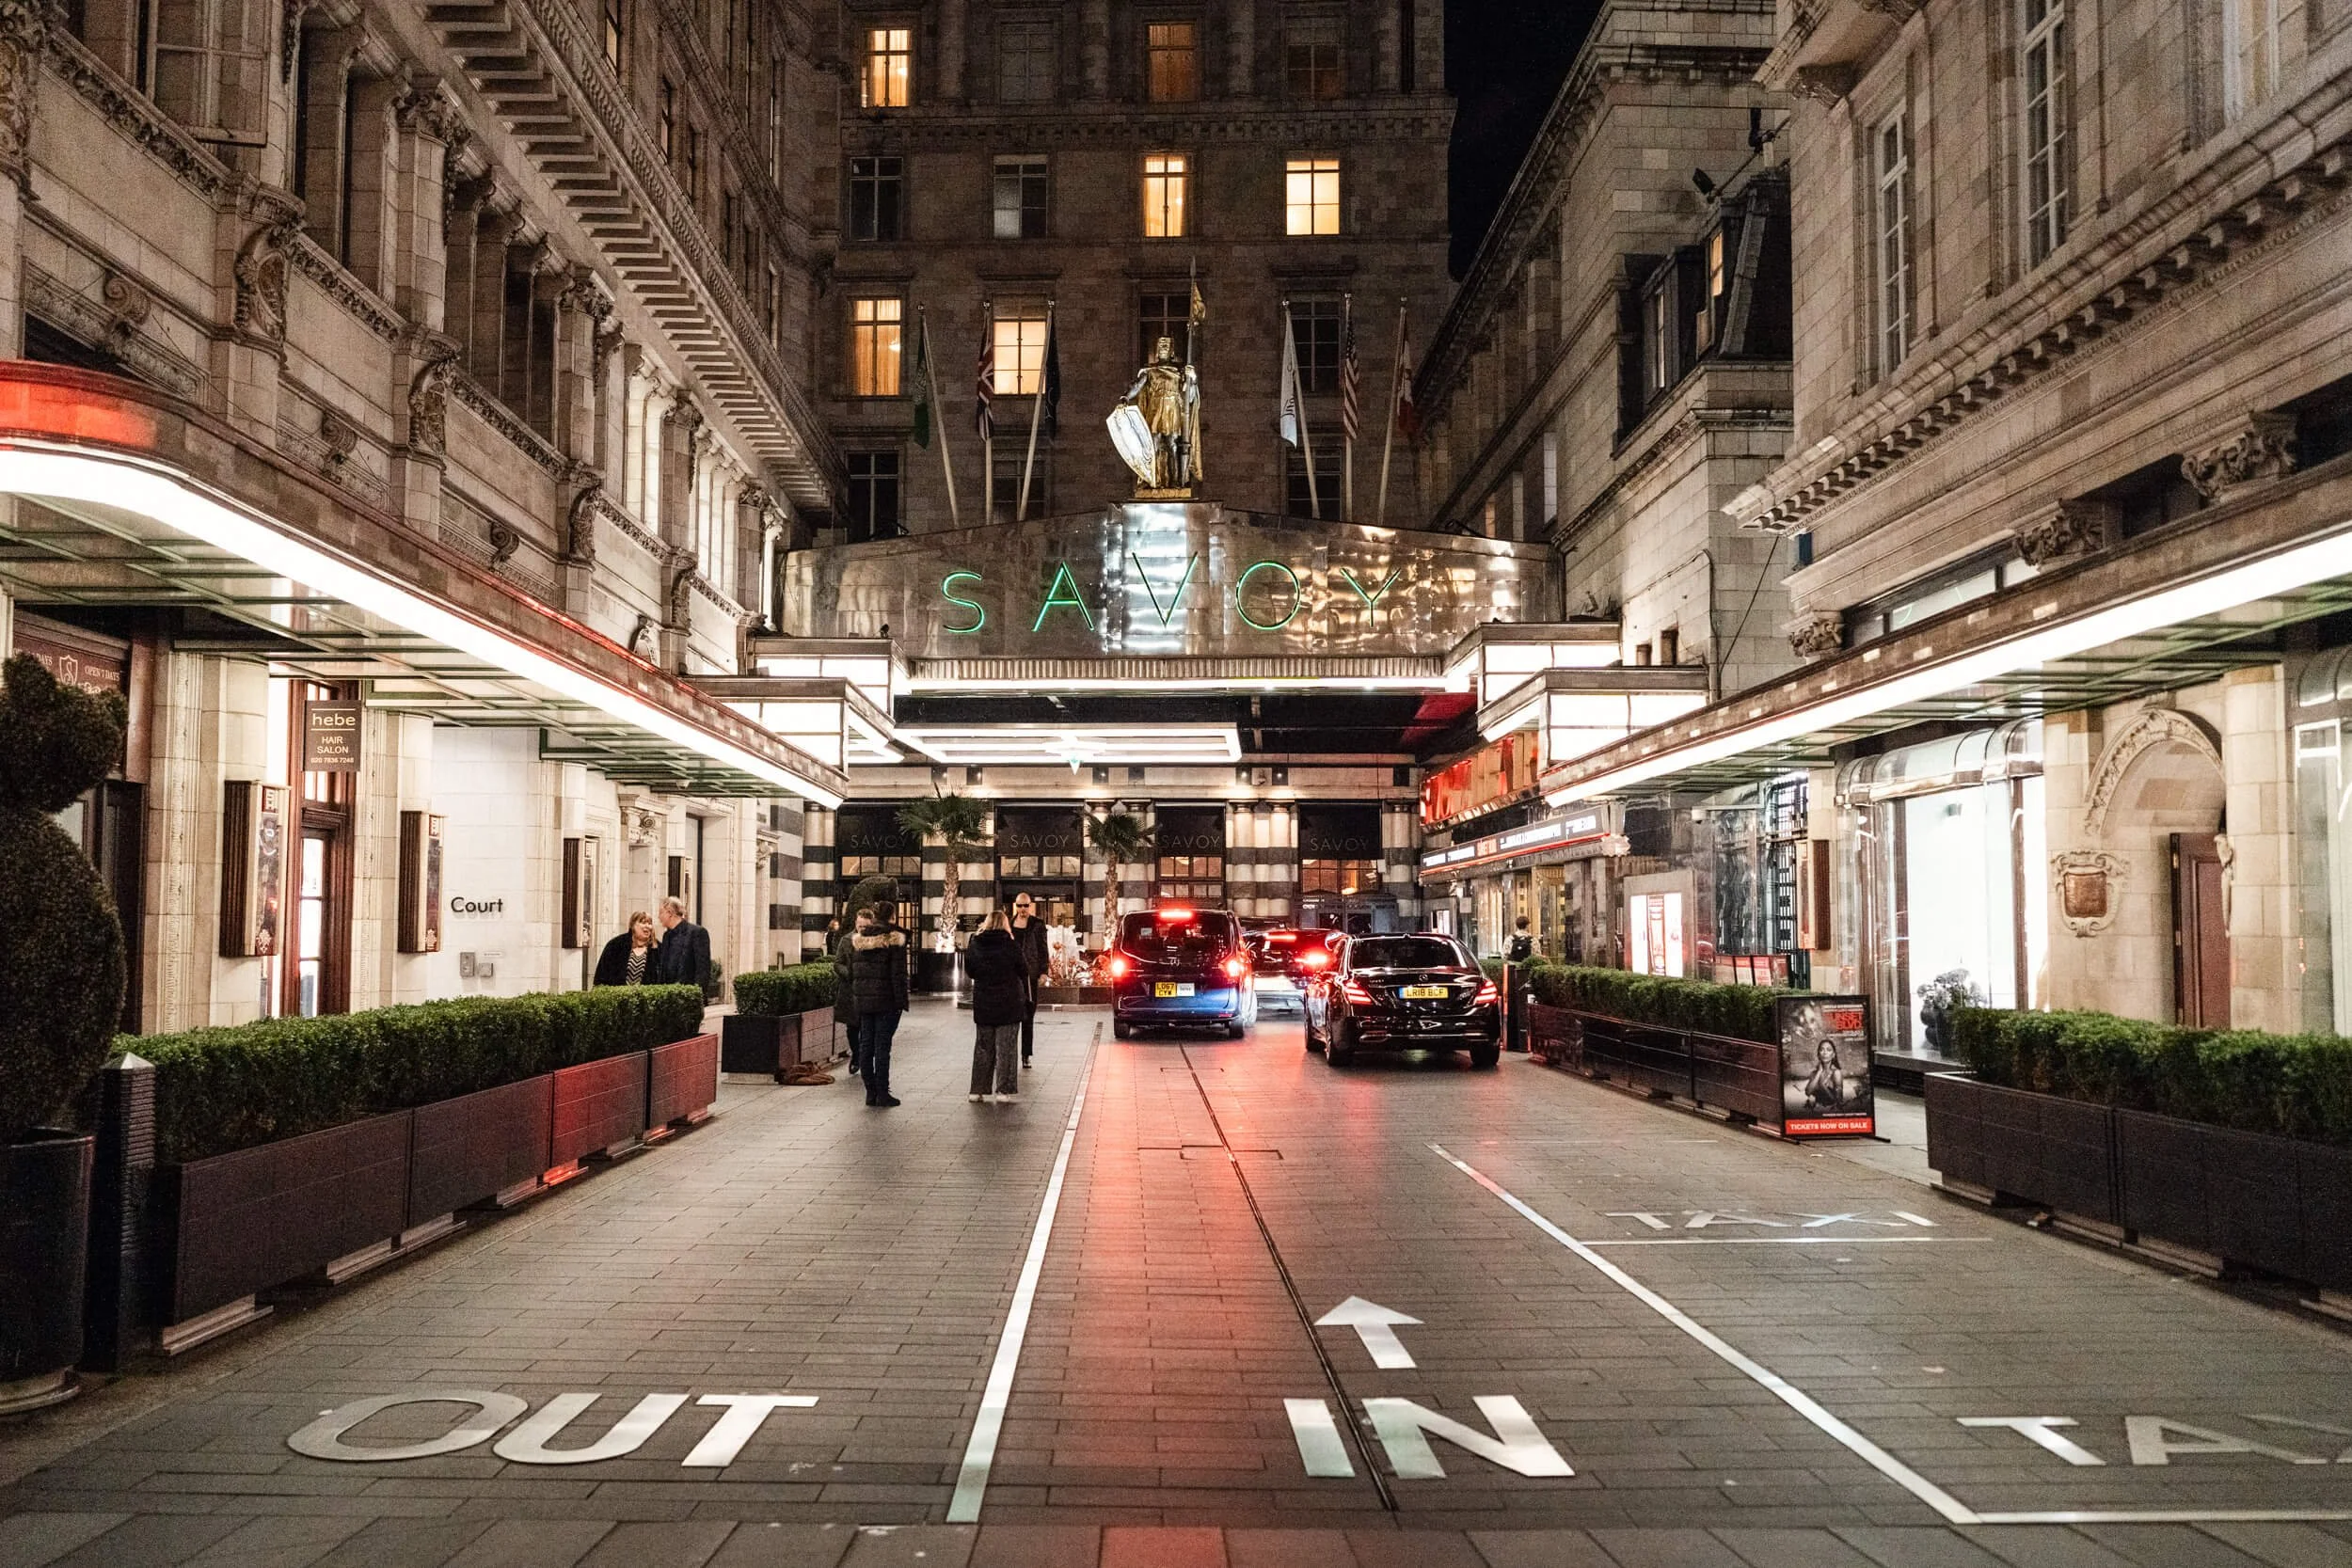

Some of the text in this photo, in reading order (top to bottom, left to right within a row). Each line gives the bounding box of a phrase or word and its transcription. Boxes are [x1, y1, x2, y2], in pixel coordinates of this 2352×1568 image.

[942, 551, 1400, 633] SAVOY
[312, 713, 356, 726] hebe
[317, 746, 349, 754] SALON
[850, 834, 908, 849] SAVOY
[1010, 834, 1070, 847] SAVOY
[1162, 834, 1220, 848] SAVOY
[1310, 837, 1370, 851] SAVOY
[451, 896, 503, 912] Court
[1604, 1211, 1941, 1228] TAXI
[287, 1390, 819, 1467] OUT
[1282, 1394, 1576, 1480] IN
